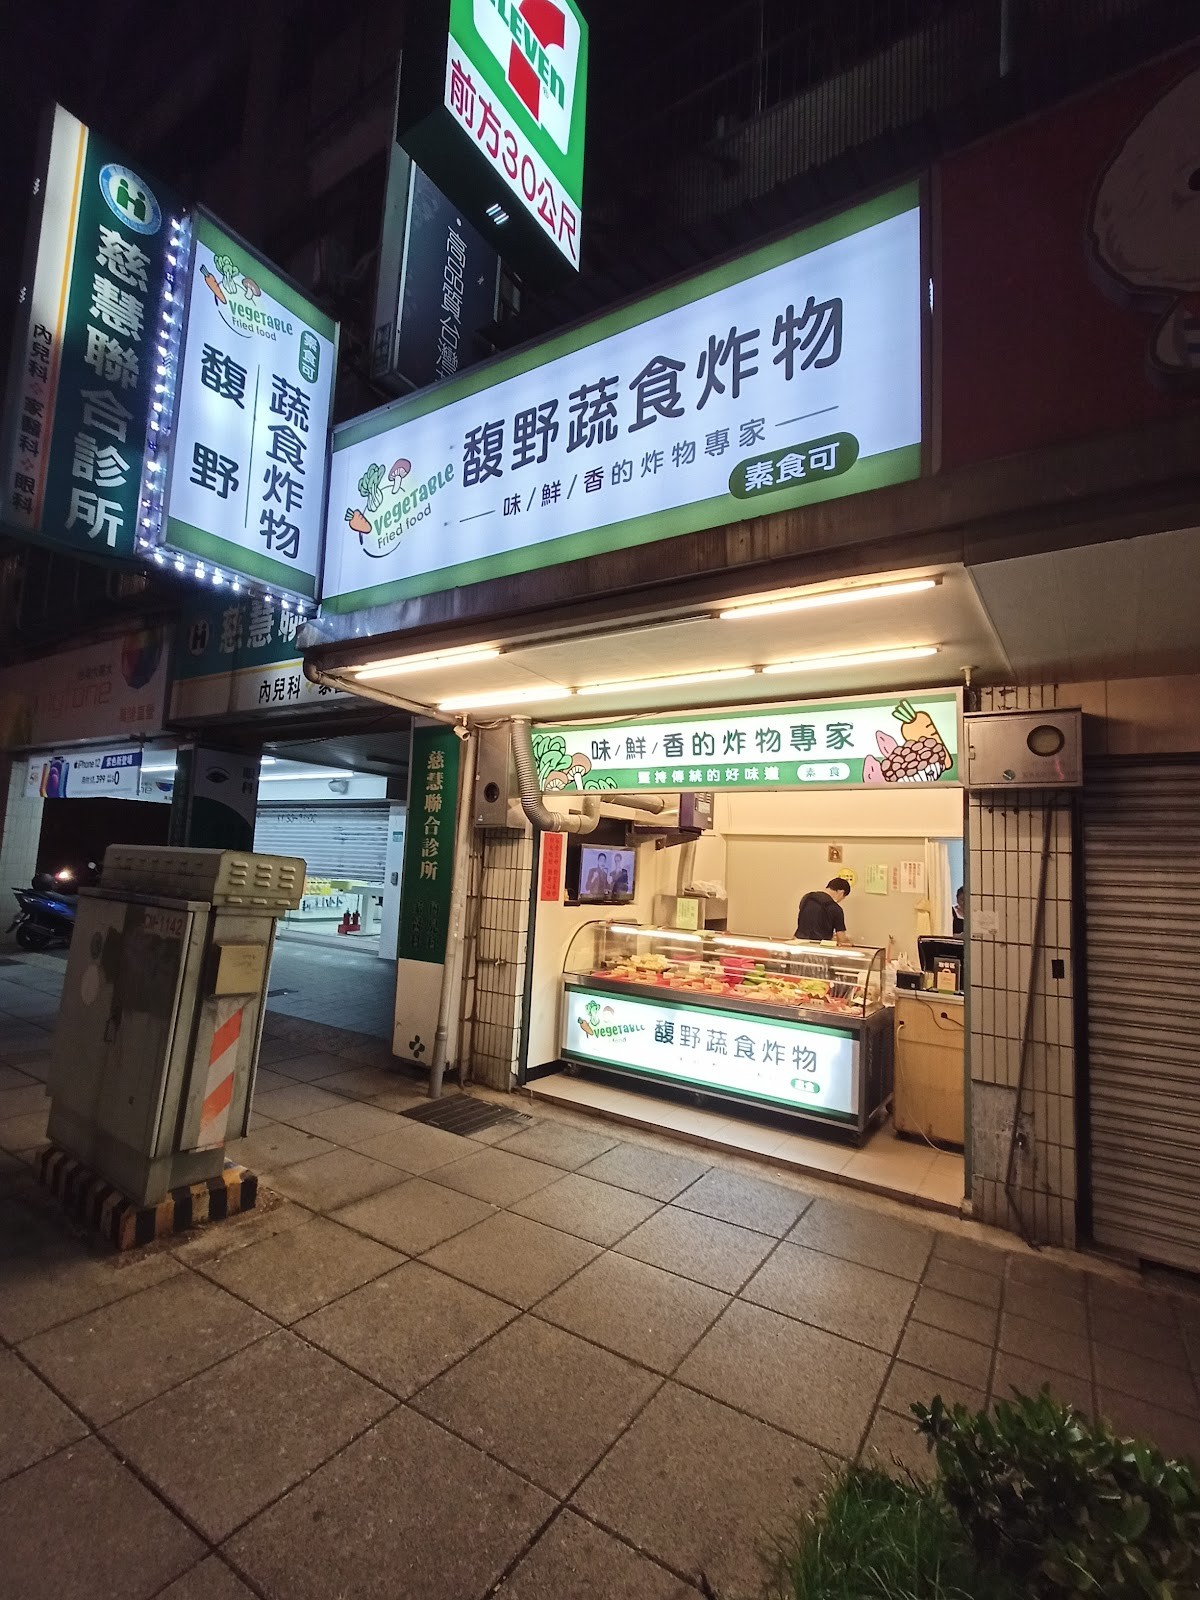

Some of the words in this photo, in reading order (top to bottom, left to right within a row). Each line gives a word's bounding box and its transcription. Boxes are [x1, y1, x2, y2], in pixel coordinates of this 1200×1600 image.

[449, 58, 577, 262] 前方30公尺
[65, 225, 151, 549] 慈慧聯合診所
[231, 316, 254, 333] Fried
[257, 325, 277, 341] food
[462, 296, 844, 489] 馥野蔬食炸物
[189, 342, 249, 502] 馥野
[259, 371, 312, 560] 蔬食炸物
[743, 440, 842, 492] 素食可
[377, 523, 403, 549] Fried
[406, 503, 432, 529] food
[258, 675, 301, 704] 內兒科
[420, 750, 446, 882] 慈慧聯合診所
[653, 1019, 818, 1073] 馥野蔬食炸物
